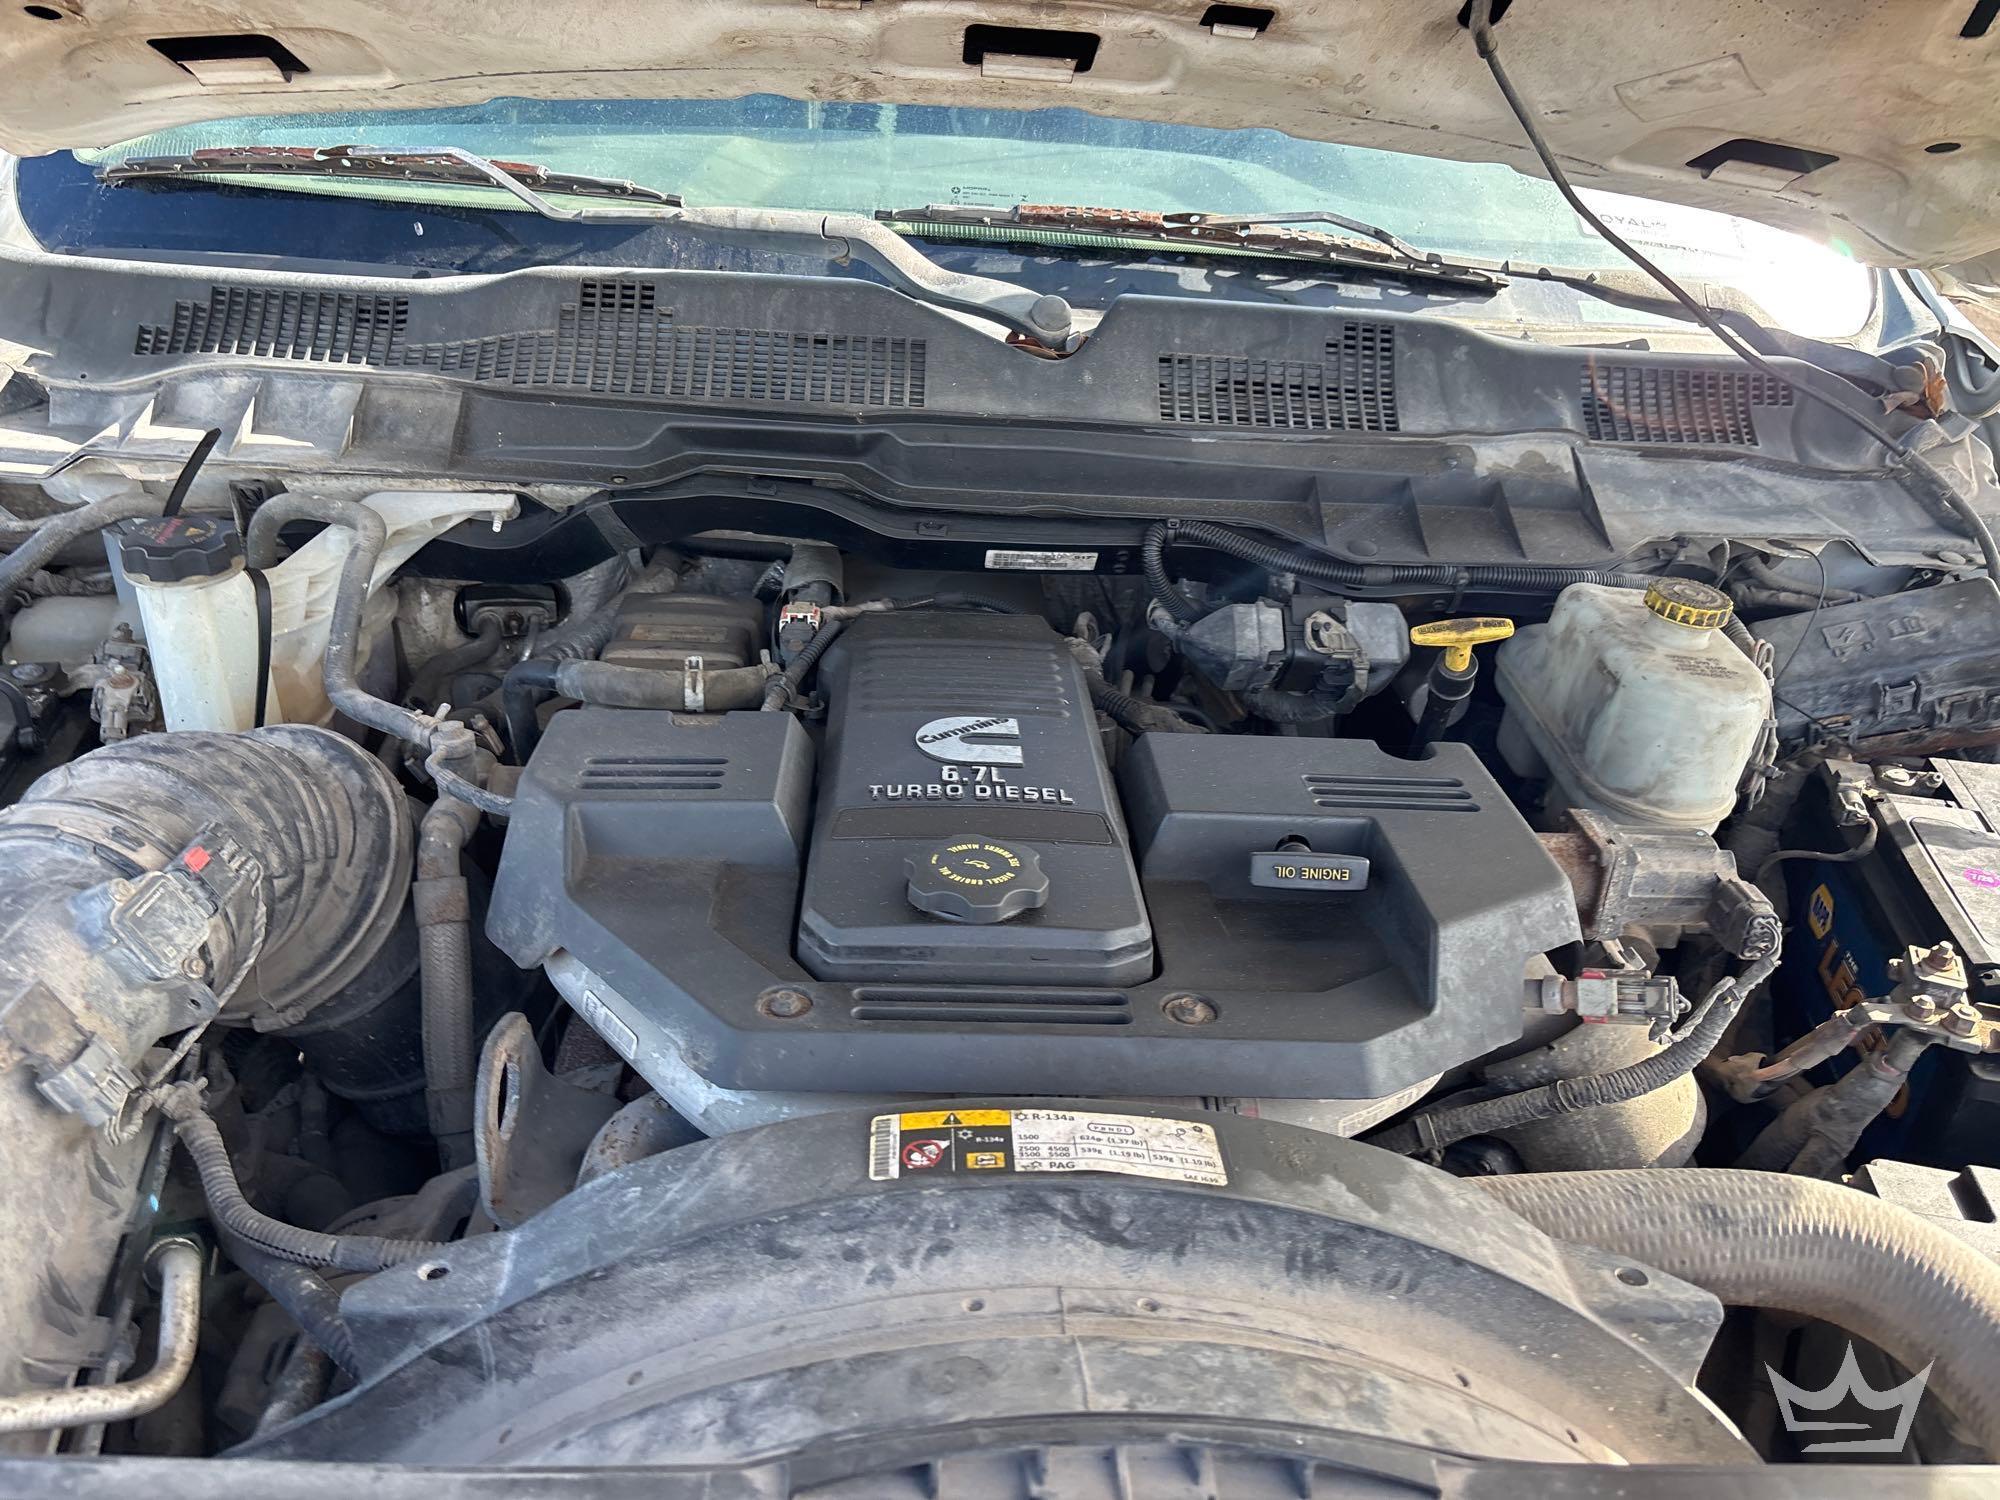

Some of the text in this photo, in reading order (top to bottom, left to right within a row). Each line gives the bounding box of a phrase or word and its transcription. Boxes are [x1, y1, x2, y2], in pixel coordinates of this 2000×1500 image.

[918, 718, 1009, 743] Cummins
[942, 765, 1006, 784] 6.7L
[869, 784, 1075, 804] TURBO DIESEL
[948, 873, 984, 885] ENGINE
[1274, 866, 1350, 881] ENGINE OIL
[1032, 1113, 1075, 1121] R-134a
[1049, 1161, 1076, 1169] PAG
